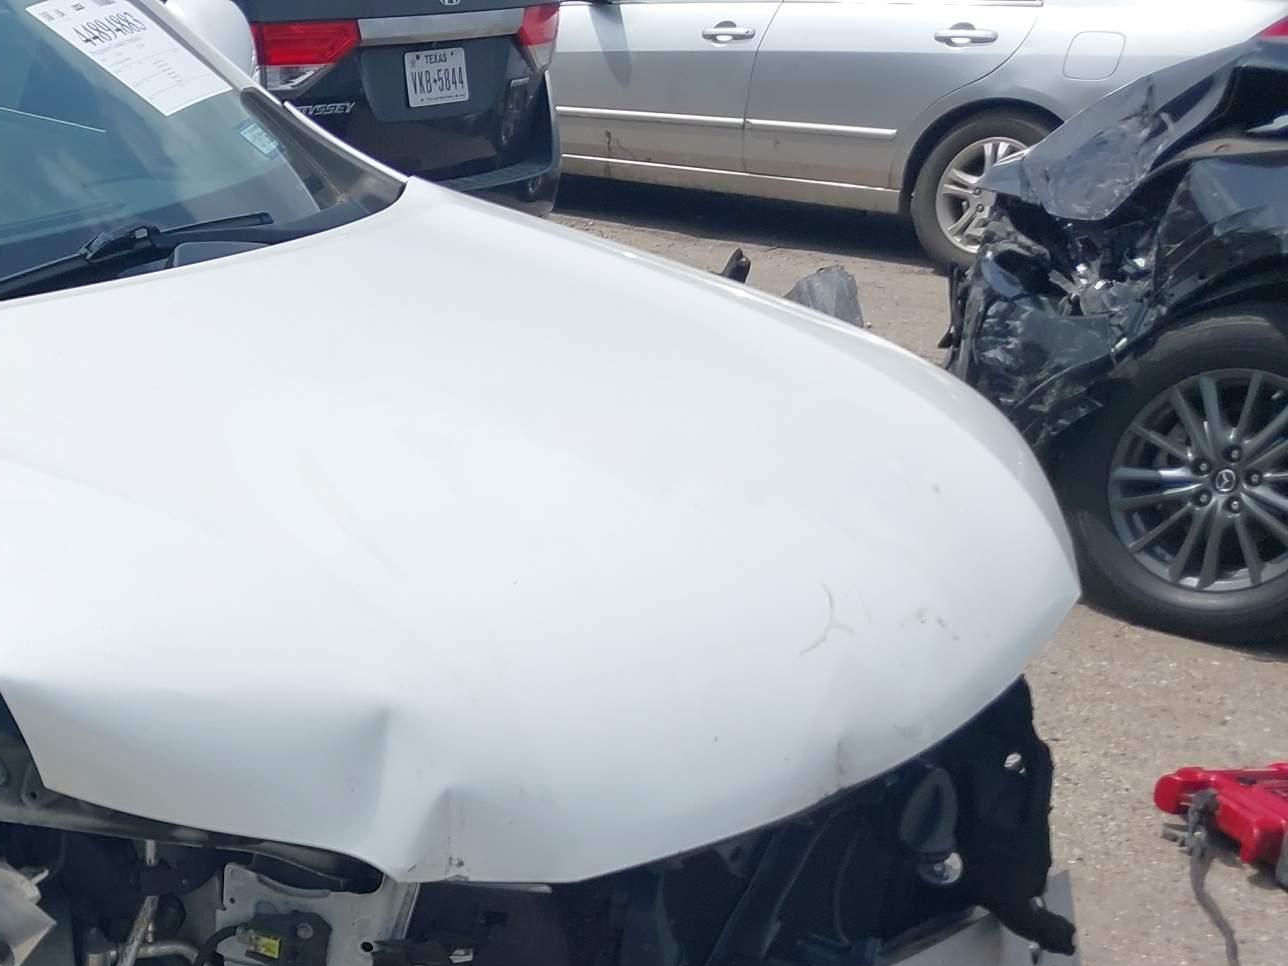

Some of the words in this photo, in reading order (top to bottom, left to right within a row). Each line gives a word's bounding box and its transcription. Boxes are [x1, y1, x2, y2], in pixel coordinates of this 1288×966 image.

[71, 11, 147, 46] 44894883
[424, 53, 448, 64] TEXAS
[295, 102, 356, 115] DYSSEY
